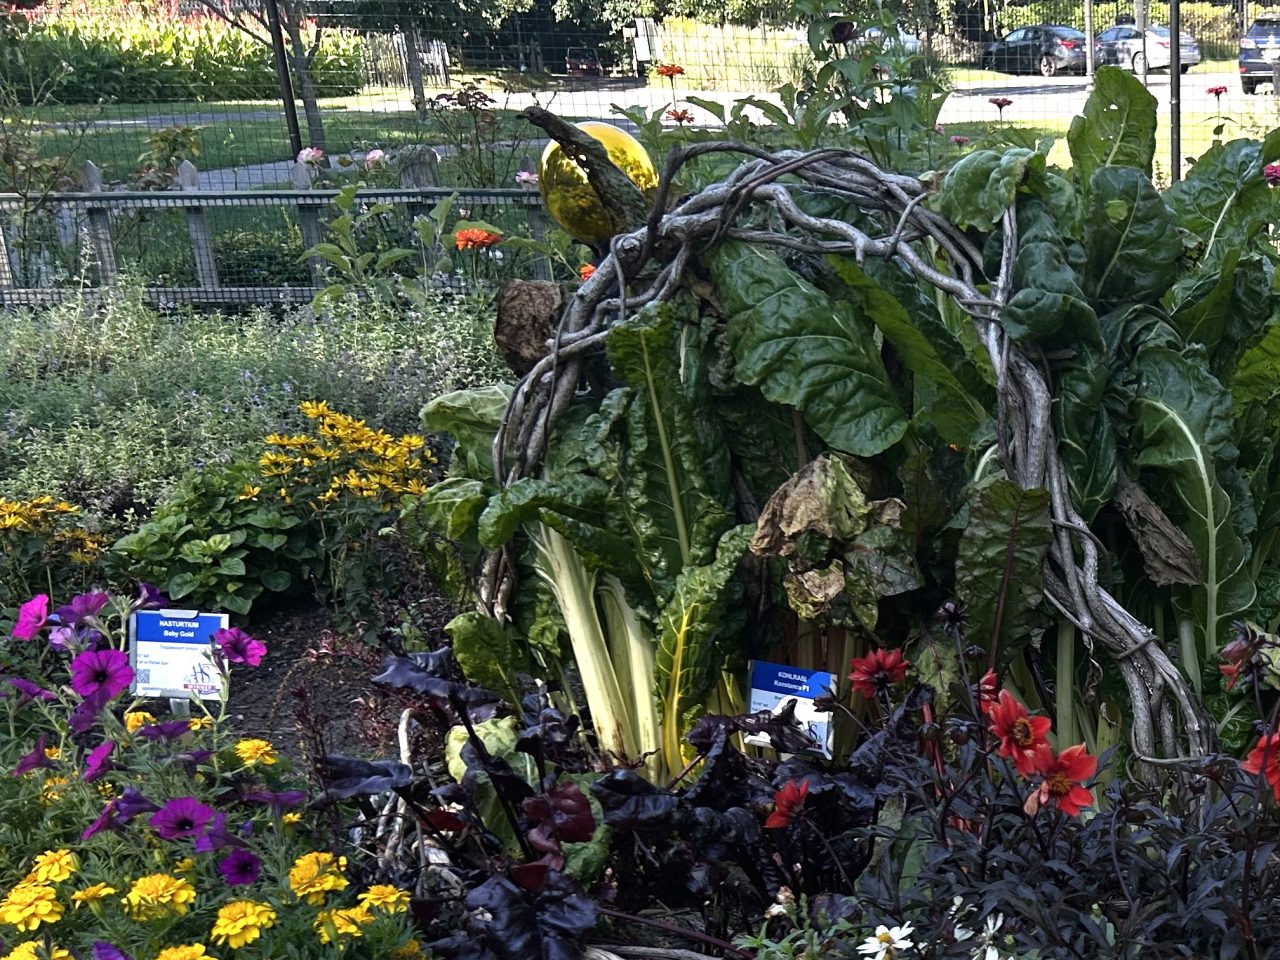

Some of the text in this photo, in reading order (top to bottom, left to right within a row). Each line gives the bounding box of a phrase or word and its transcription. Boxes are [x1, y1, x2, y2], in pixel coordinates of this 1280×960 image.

[159, 620, 199, 628] NASTURTIUM
[163, 630, 179, 638] Baby
[778, 671, 808, 682] KOHLRABI
